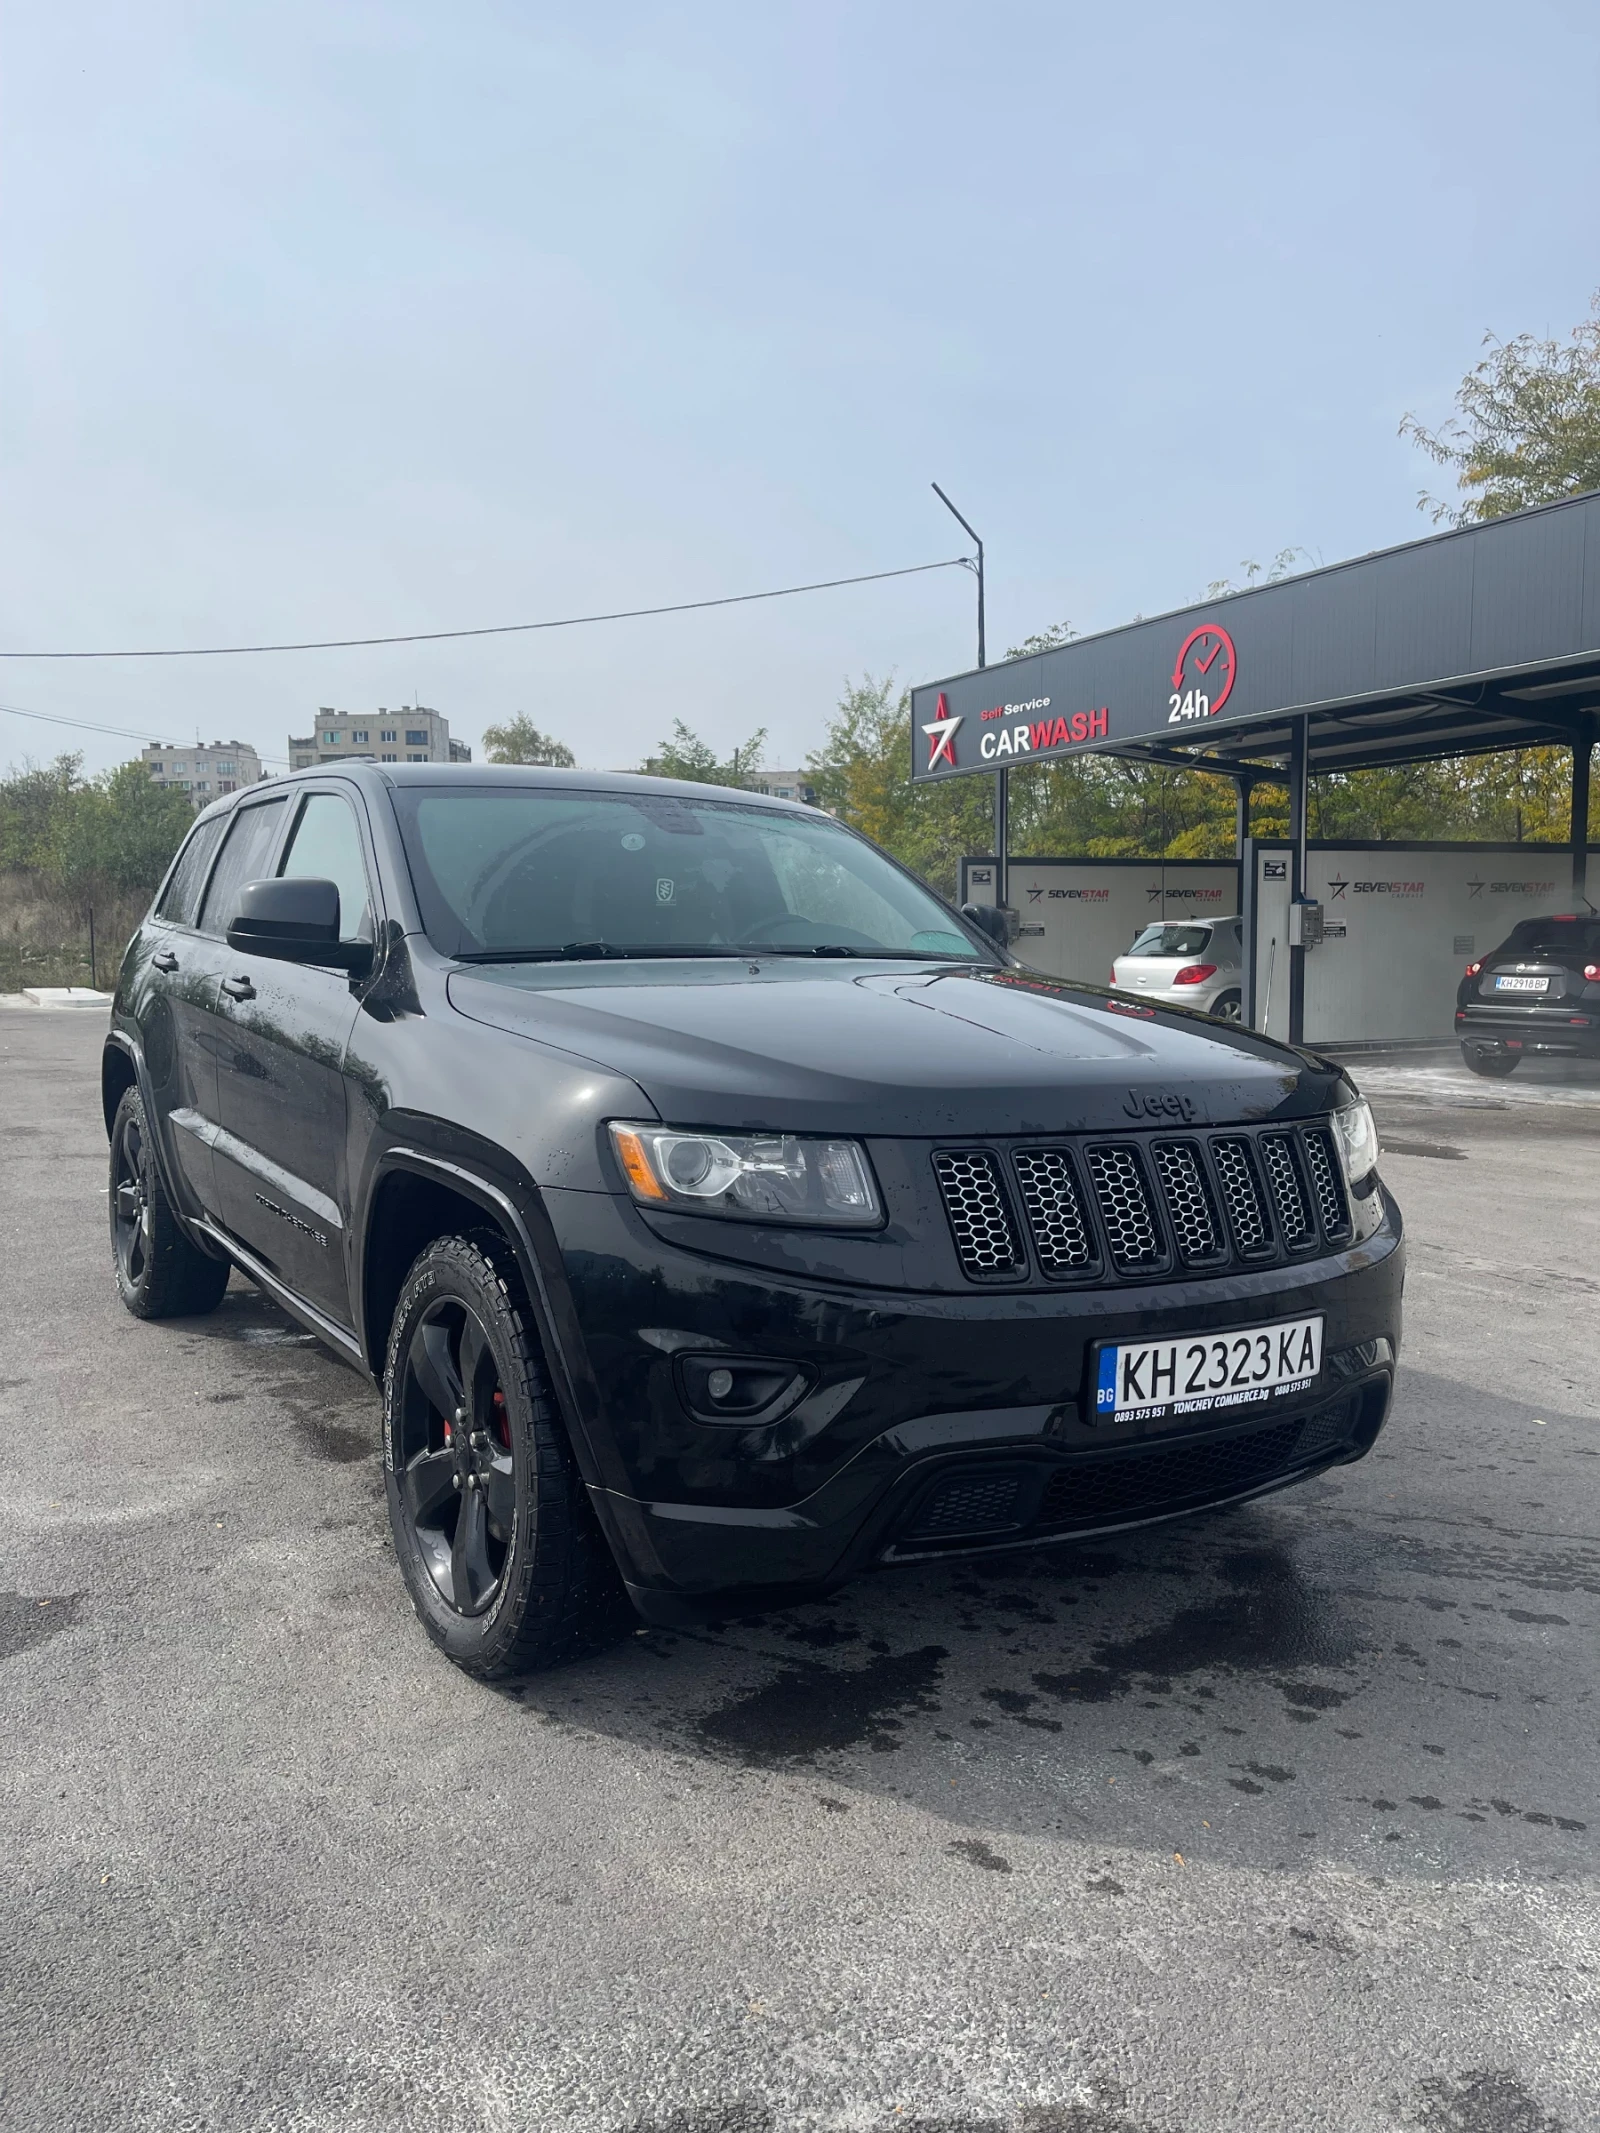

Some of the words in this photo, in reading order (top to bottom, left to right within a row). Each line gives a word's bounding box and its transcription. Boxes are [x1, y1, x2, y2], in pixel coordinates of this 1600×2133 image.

[980, 706, 1003, 722] Self
[1003, 695, 1051, 716] Service
[1168, 689, 1209, 724] 24h
[980, 707, 1109, 759] CARWASH
[1123, 1088, 1197, 1122] Jeep
[1097, 1388, 1114, 1405] BG
[1135, 1409, 1150, 1420] 575
[1173, 1397, 1214, 1415] TONCHEV
